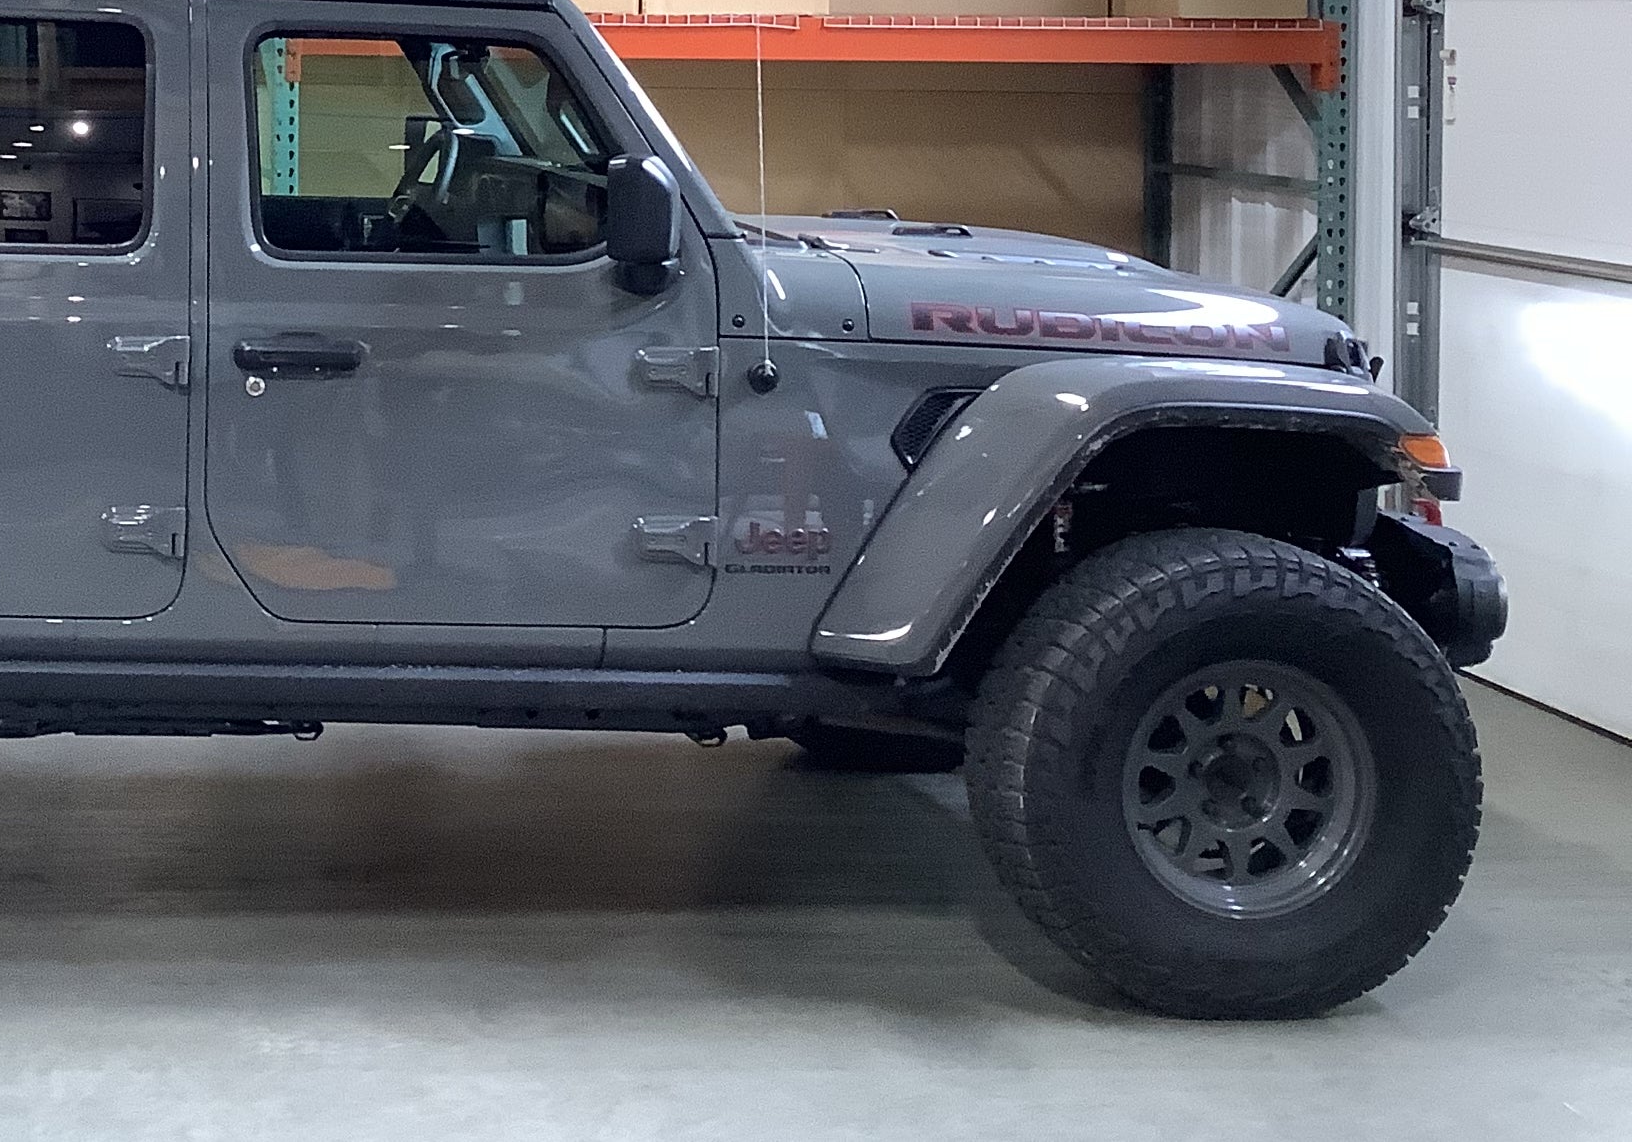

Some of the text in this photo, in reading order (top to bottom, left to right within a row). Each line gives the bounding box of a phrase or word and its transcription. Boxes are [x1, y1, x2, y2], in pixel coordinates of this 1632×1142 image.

[911, 302, 1290, 352] RUBICON
[734, 522, 832, 560] Jeep
[724, 563, 831, 574] GLADIATOR
